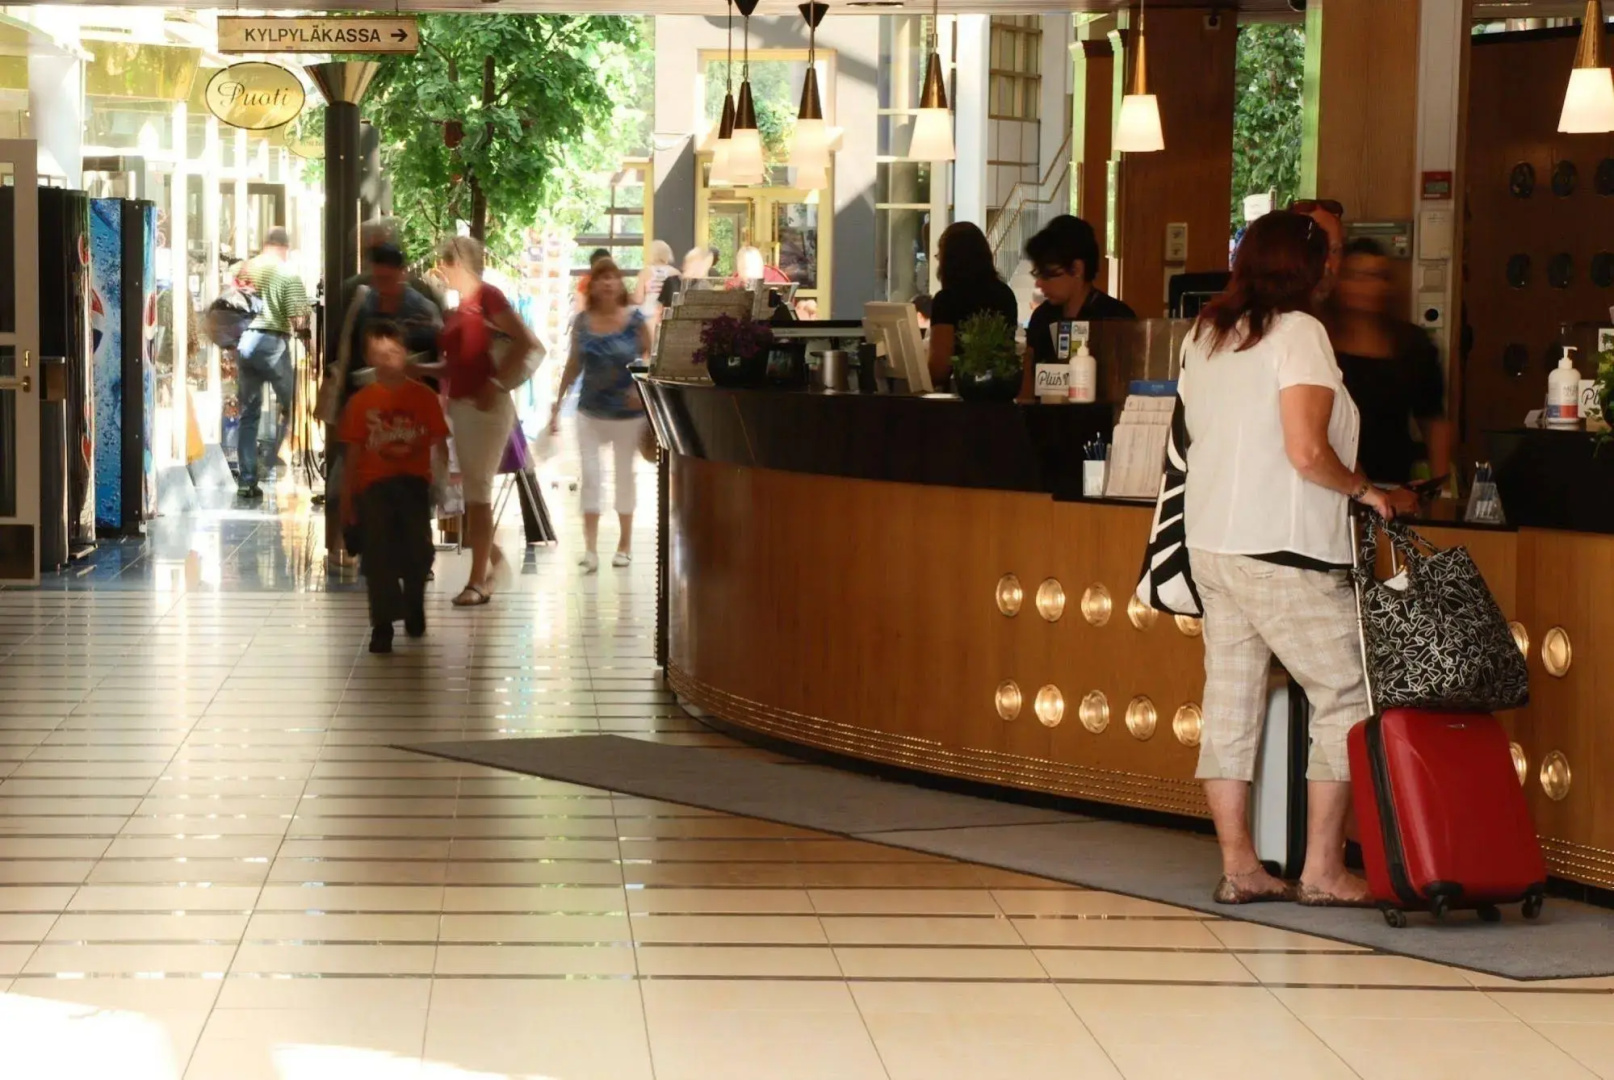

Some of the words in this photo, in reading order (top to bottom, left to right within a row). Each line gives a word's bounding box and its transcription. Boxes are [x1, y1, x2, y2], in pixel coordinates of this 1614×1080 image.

[244, 25, 381, 43] KYLPYLÄKASSA
[217, 81, 289, 107] Puoti
[1038, 370, 1062, 386] Plus
